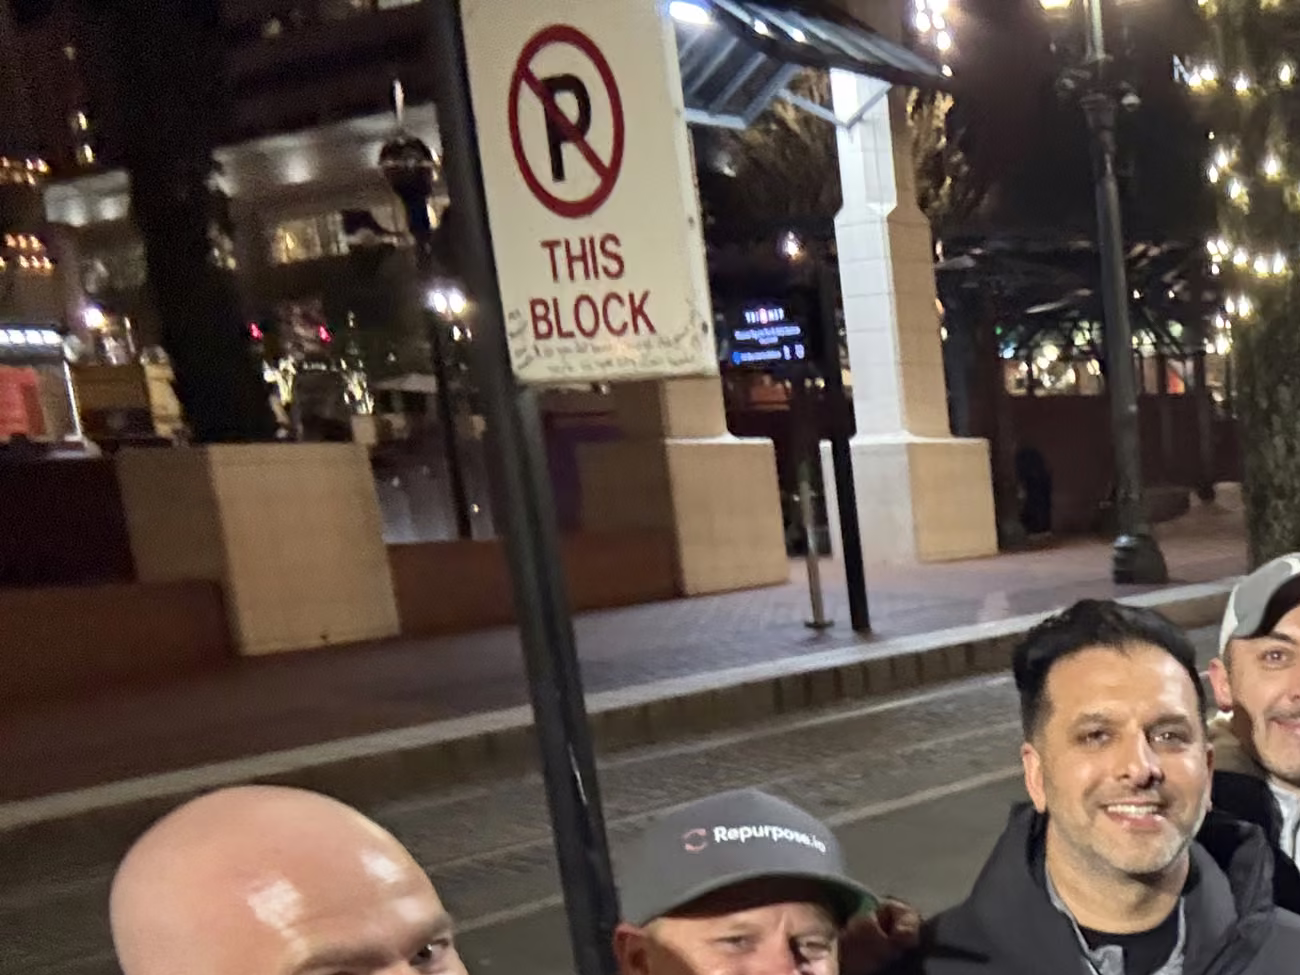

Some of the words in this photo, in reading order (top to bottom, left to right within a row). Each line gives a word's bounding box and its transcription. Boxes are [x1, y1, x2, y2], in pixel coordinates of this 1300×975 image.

[540, 233, 625, 282] THIS
[529, 290, 656, 340] BLOCK
[713, 825, 826, 853] Repurpose.io
